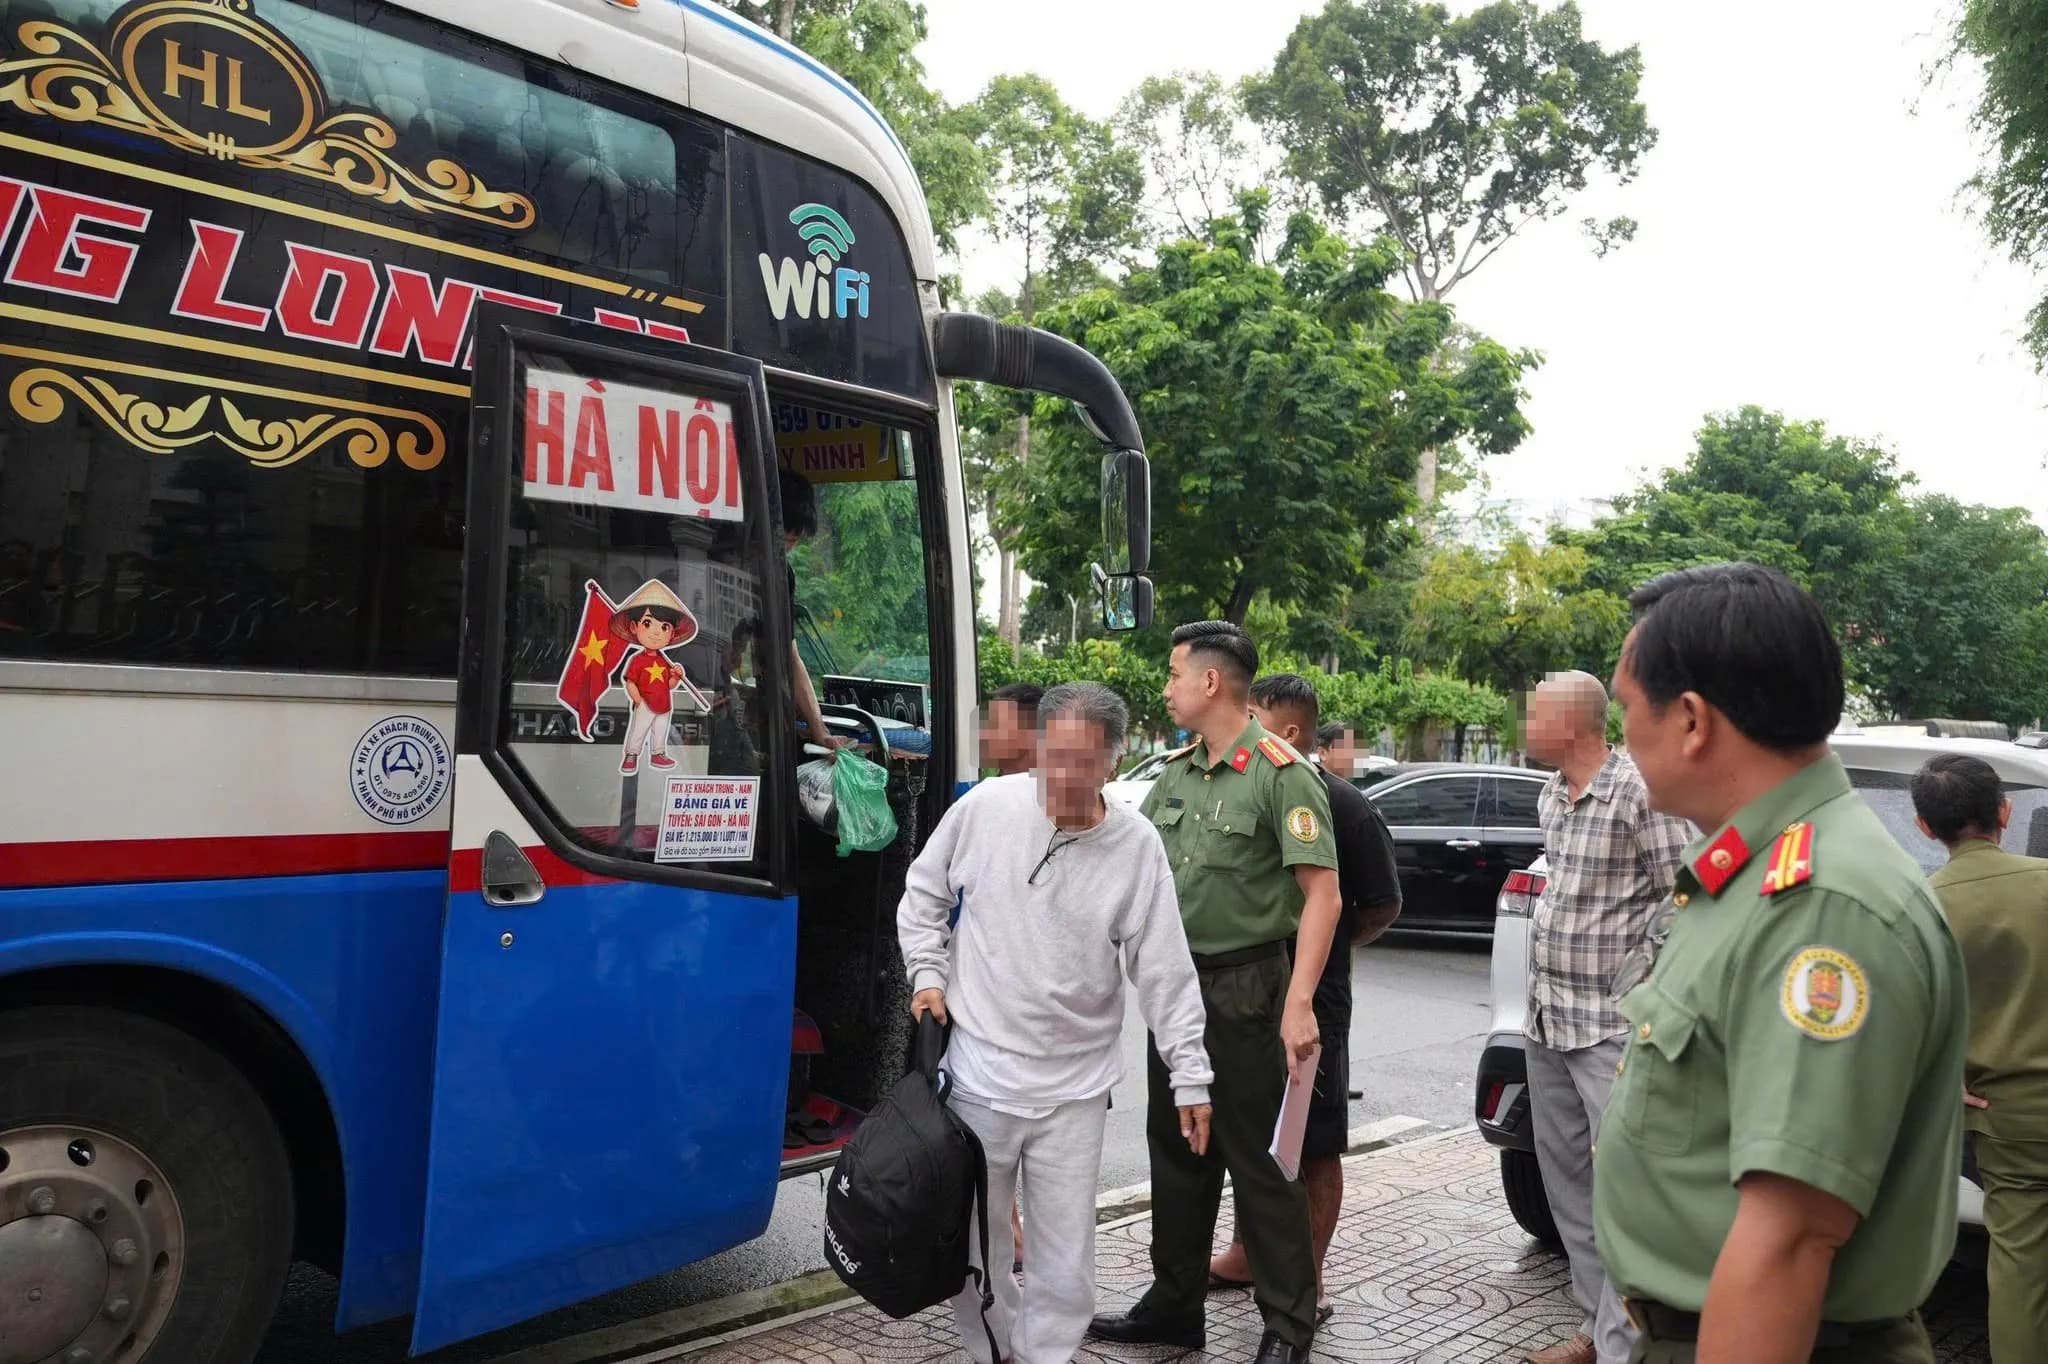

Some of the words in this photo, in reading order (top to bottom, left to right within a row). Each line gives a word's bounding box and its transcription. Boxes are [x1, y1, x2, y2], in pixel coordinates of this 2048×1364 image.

[162, 38, 271, 125] HL
[170, 218, 563, 369] LON
[759, 252, 870, 320] WiFi
[524, 378, 615, 492] HÀ
[638, 397, 738, 518] NỘI
[804, 441, 866, 470] NINH
[358, 745, 372, 764] HTX
[367, 734, 380, 747] XE
[411, 723, 436, 745] TRUNG
[432, 743, 446, 764] NAM
[425, 780, 443, 805] MINH
[671, 783, 684, 793] HTX
[684, 783, 693, 793] XE
[715, 784, 735, 793] TRUNG
[739, 784, 752, 793] NAM
[674, 794, 708, 809] BẢNG
[711, 796, 731, 809] GIÁ
[734, 796, 749, 809] VÉ
[826, 1214, 858, 1274] didas
